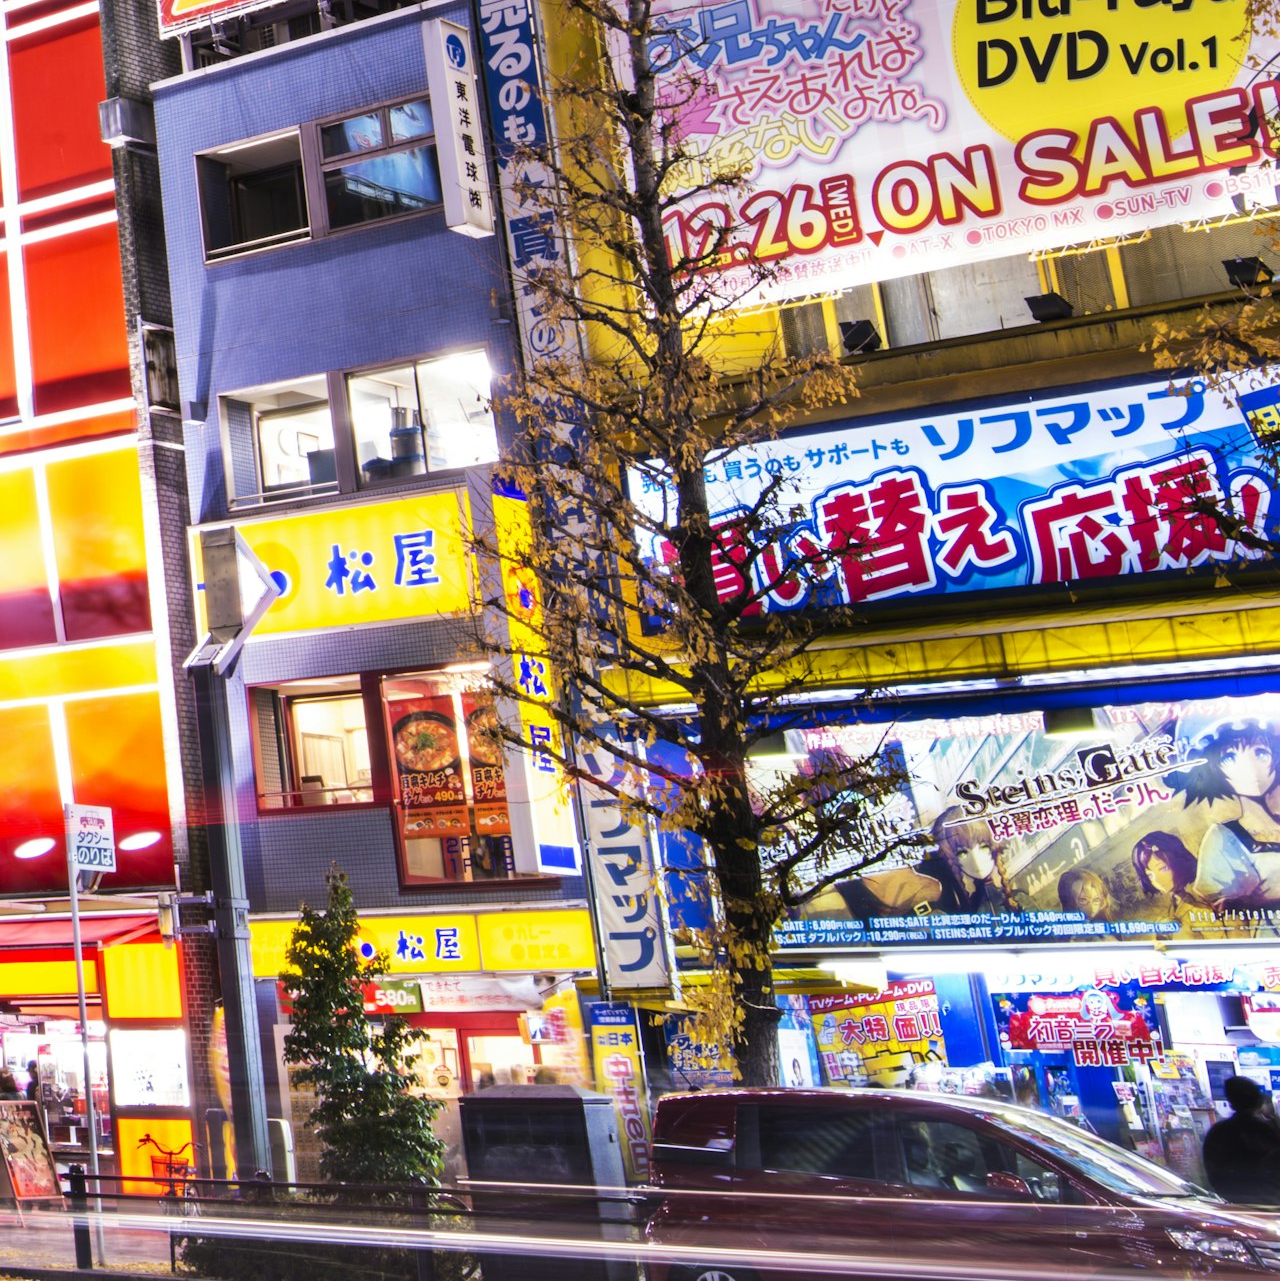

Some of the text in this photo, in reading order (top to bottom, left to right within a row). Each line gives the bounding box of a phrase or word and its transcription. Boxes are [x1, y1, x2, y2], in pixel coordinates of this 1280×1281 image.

[976, 30, 1221, 89] DVD Vol.1
[874, 147, 1000, 232] ON
[1114, 185, 1193, 219] SUN-TV
[983, 208, 1085, 245] TOKYO MX
[921, 378, 1209, 462] ソフマップ
[325, 529, 441, 598] 松屋
[400, 771, 446, 791] 豆腐キムチ
[988, 779, 1173, 845] 比翼恋理のだーりん
[77, 830, 110, 845] タクシー
[78, 846, 113, 866] のりば
[580, 734, 658, 975] ソフマップ
[395, 926, 463, 962] 松屋
[1027, 1016, 1116, 1043] 初音ミク
